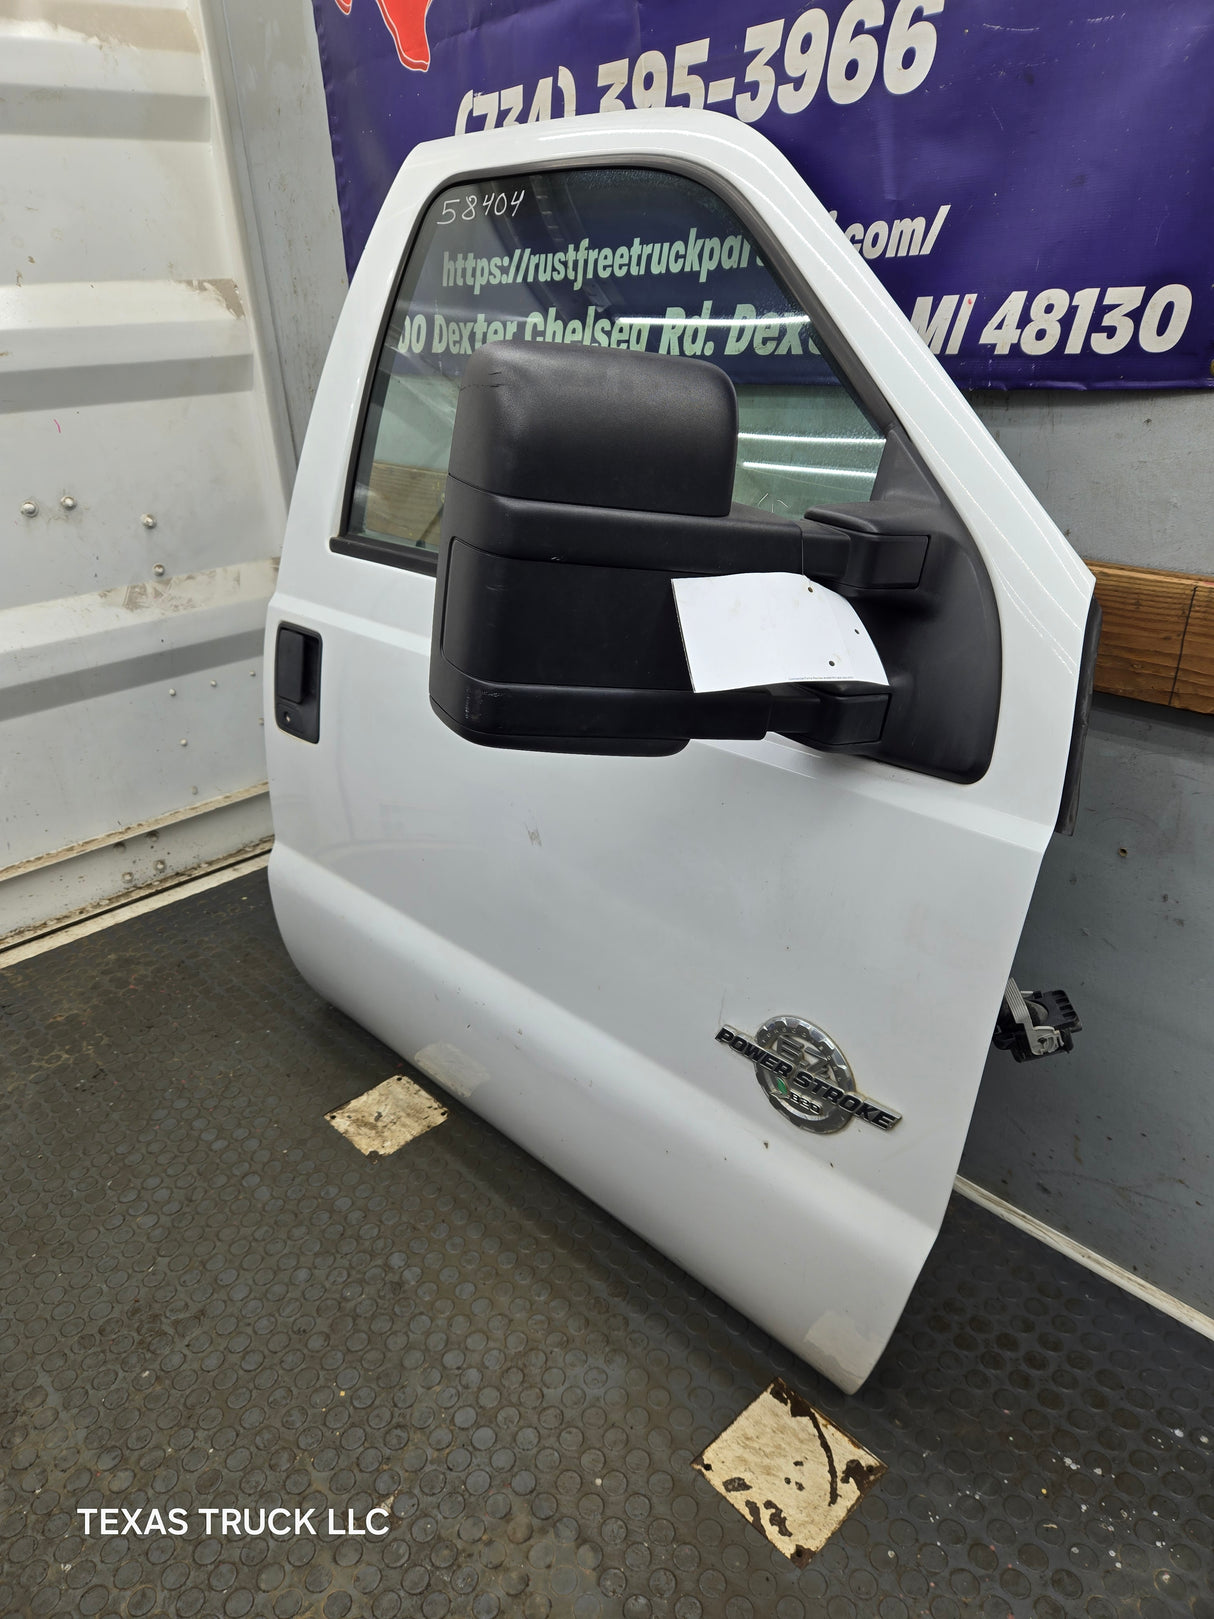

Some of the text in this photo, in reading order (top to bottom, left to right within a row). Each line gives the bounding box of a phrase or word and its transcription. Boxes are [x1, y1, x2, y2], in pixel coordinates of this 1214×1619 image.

[597, 0, 945, 123] 395-3966
[436, 189, 526, 225] 58404
[442, 228, 764, 294] https://rustfreetruckpar
[431, 313, 518, 355] Dexter
[525, 305, 650, 351] Chelsea
[657, 300, 715, 356] Rd.
[724, 303, 822, 356] Dex
[910, 293, 978, 355] MI
[978, 284, 1193, 356] 48130
[715, 1025, 796, 1079] POWER
[792, 1069, 902, 1131] STROKE
